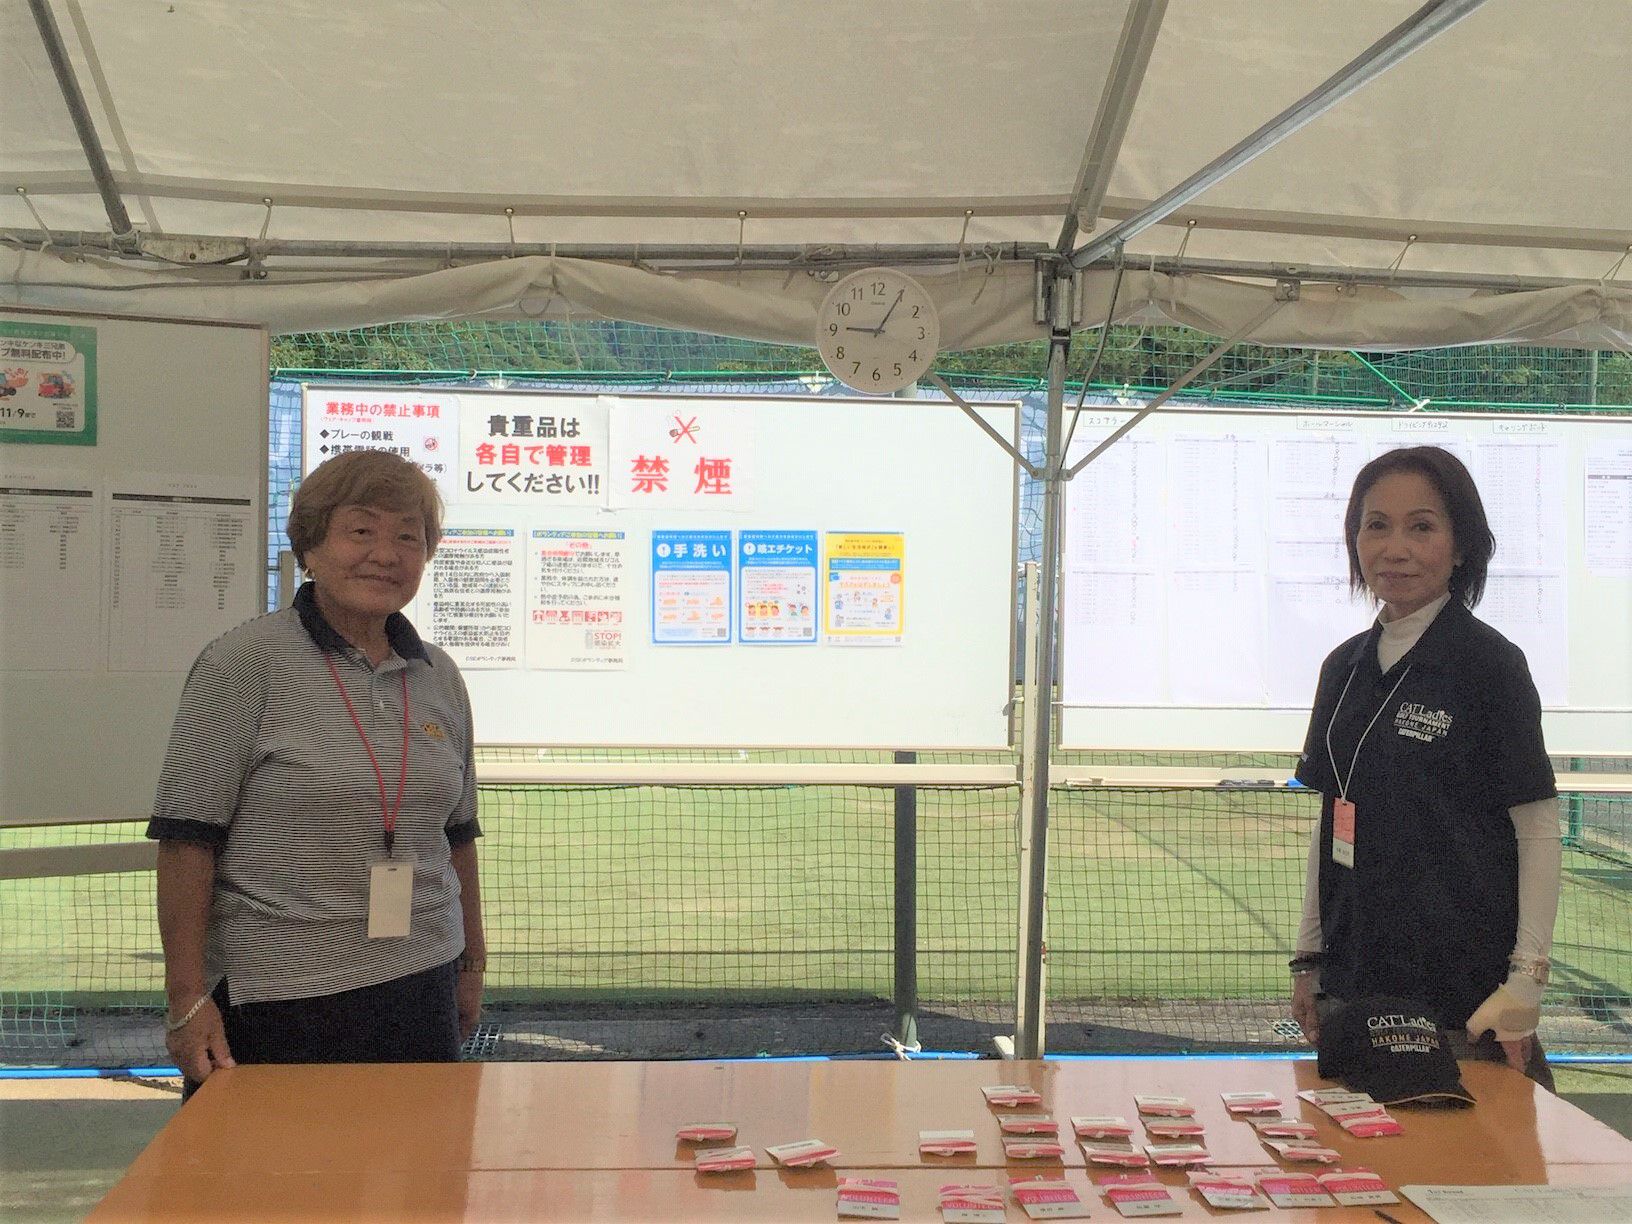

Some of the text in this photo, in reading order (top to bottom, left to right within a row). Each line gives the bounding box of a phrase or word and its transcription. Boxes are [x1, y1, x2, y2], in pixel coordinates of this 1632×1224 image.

[850, 287, 863, 301] 11
[870, 281, 886, 296] 12
[835, 302, 851, 316] 10
[911, 305, 920, 319] 2
[829, 323, 838, 337] 9
[917, 326, 925, 340] 3
[836, 346, 845, 360] 8
[908, 349, 917, 362] 4
[852, 361, 861, 375] 7
[872, 368, 881, 381] 6
[893, 362, 902, 376] 5
[326, 401, 441, 418] 業務中の禁止事項
[487, 414, 580, 438] 貴重品は
[331, 429, 394, 441] プレーの観戦
[475, 444, 593, 467] 各自で管理
[631, 454, 733, 495] 禁煙
[466, 471, 600, 496] してください!!
[673, 543, 727, 559] 手洗い
